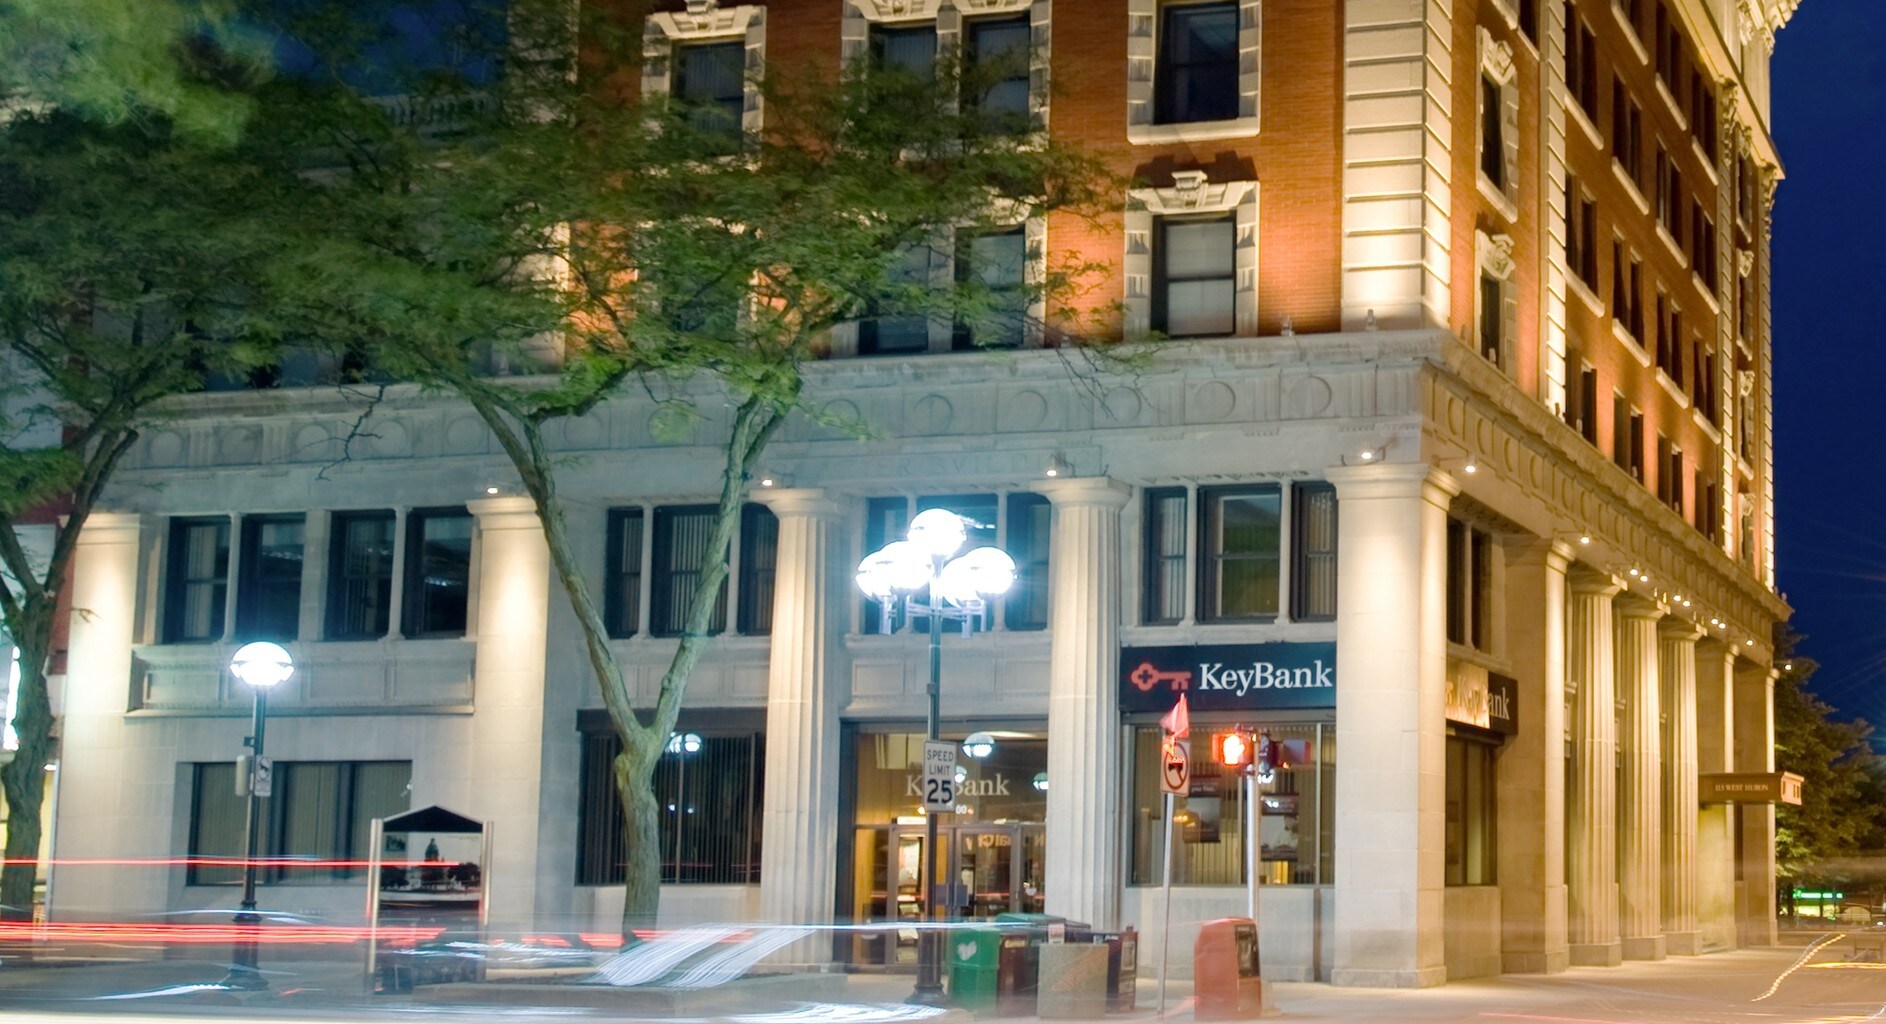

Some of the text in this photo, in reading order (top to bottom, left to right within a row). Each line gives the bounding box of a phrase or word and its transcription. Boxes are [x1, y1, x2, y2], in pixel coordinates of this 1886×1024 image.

[1199, 660, 1333, 697] KeyBank
[1456, 674, 1510, 721] Keyank
[926, 749, 954, 763] SPEED
[929, 765, 951, 776] LIMIT
[905, 773, 1010, 796] Kank
[926, 778, 953, 804] 25
[1725, 783, 1743, 792] WEST
